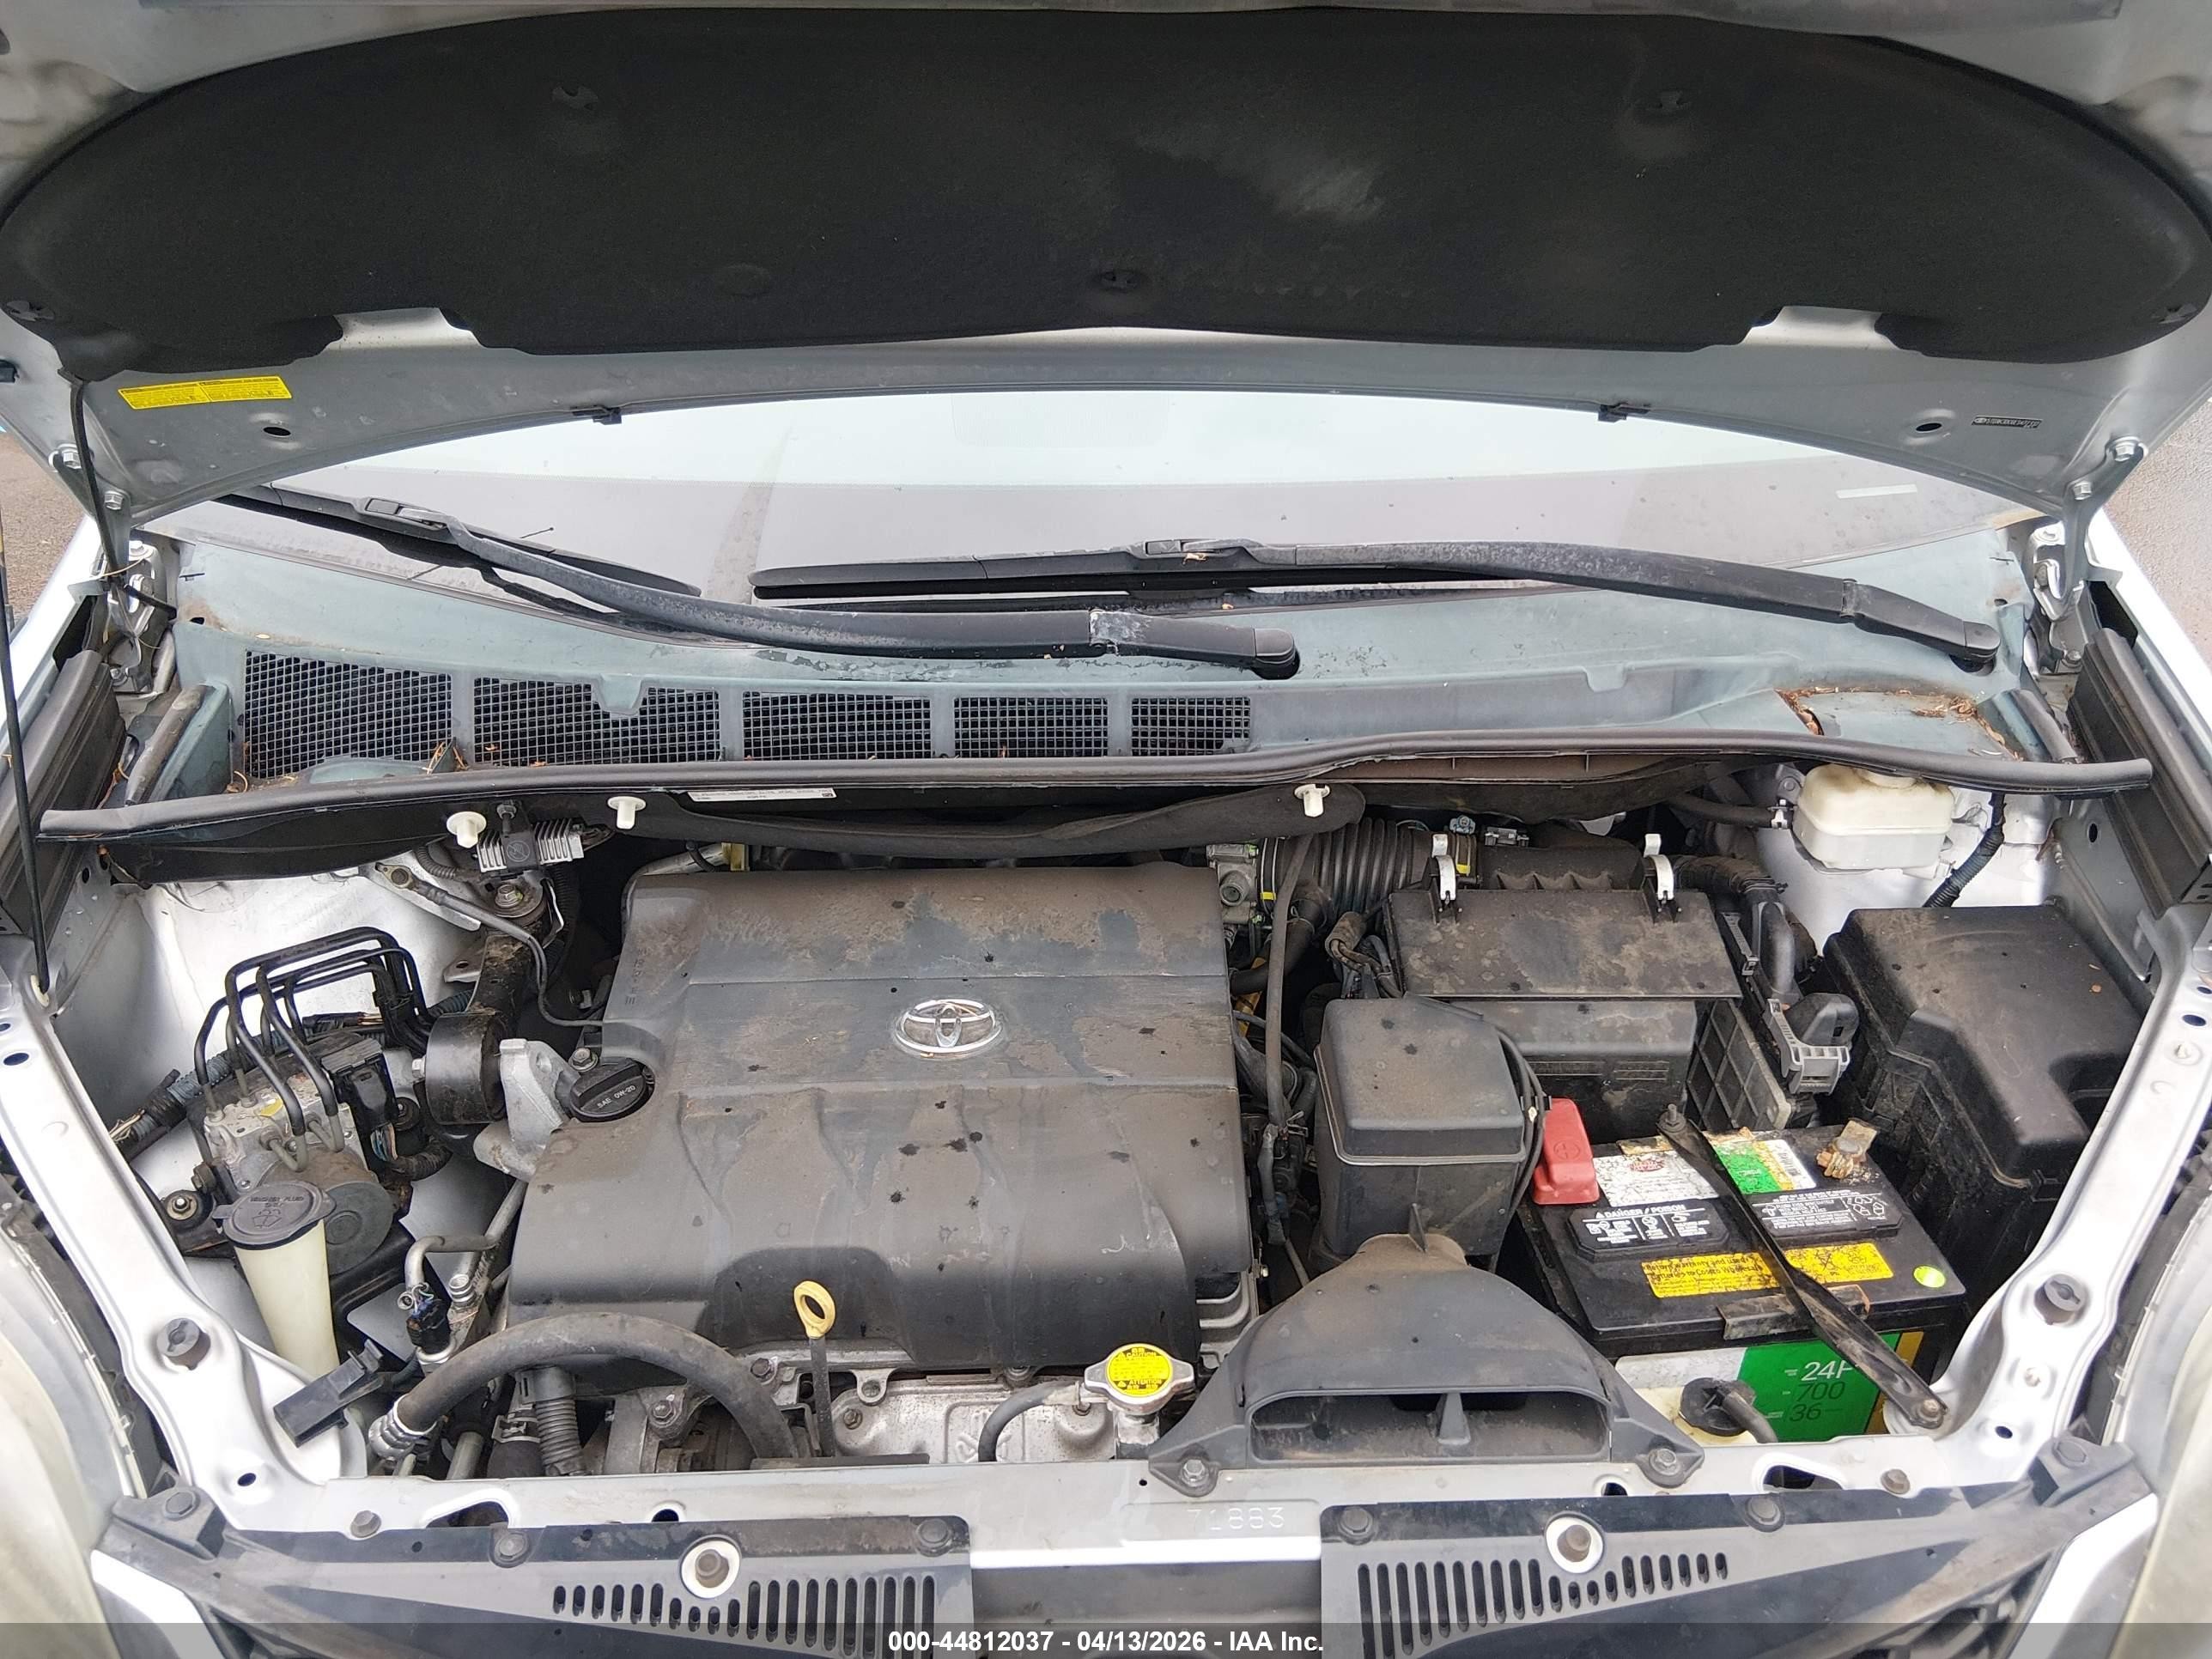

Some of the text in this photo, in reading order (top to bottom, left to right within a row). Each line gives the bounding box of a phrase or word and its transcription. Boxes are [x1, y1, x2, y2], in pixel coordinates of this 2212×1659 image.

[597, 1085, 636, 1109] SAE 0W-20
[1650, 1204, 1686, 1213] POISON
[1801, 1359, 1854, 1382] 24F
[1796, 1381, 1845, 1402] 700
[1789, 1402, 1823, 1422] 36
